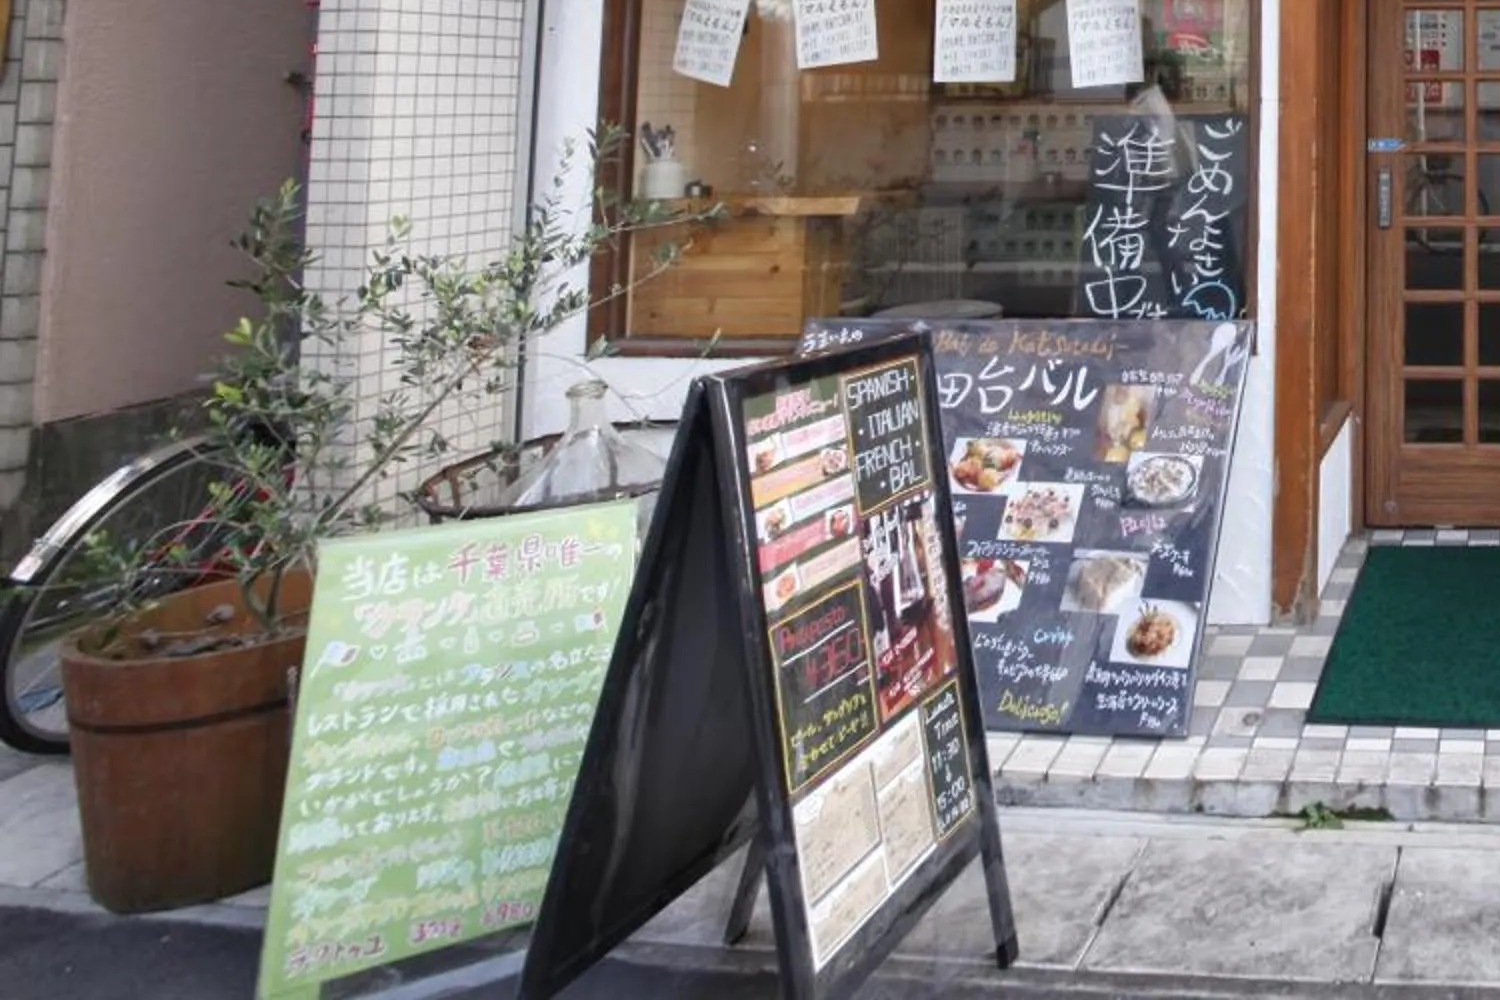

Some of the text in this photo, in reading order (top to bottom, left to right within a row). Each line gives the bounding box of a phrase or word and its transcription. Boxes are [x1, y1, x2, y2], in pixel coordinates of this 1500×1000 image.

[1168, 118, 1243, 295] ごめんなさい
[848, 367, 909, 410] SPANISH
[868, 399, 919, 439] ITALIAN
[856, 435, 913, 483] FRENCH
[890, 460, 922, 494] BAL
